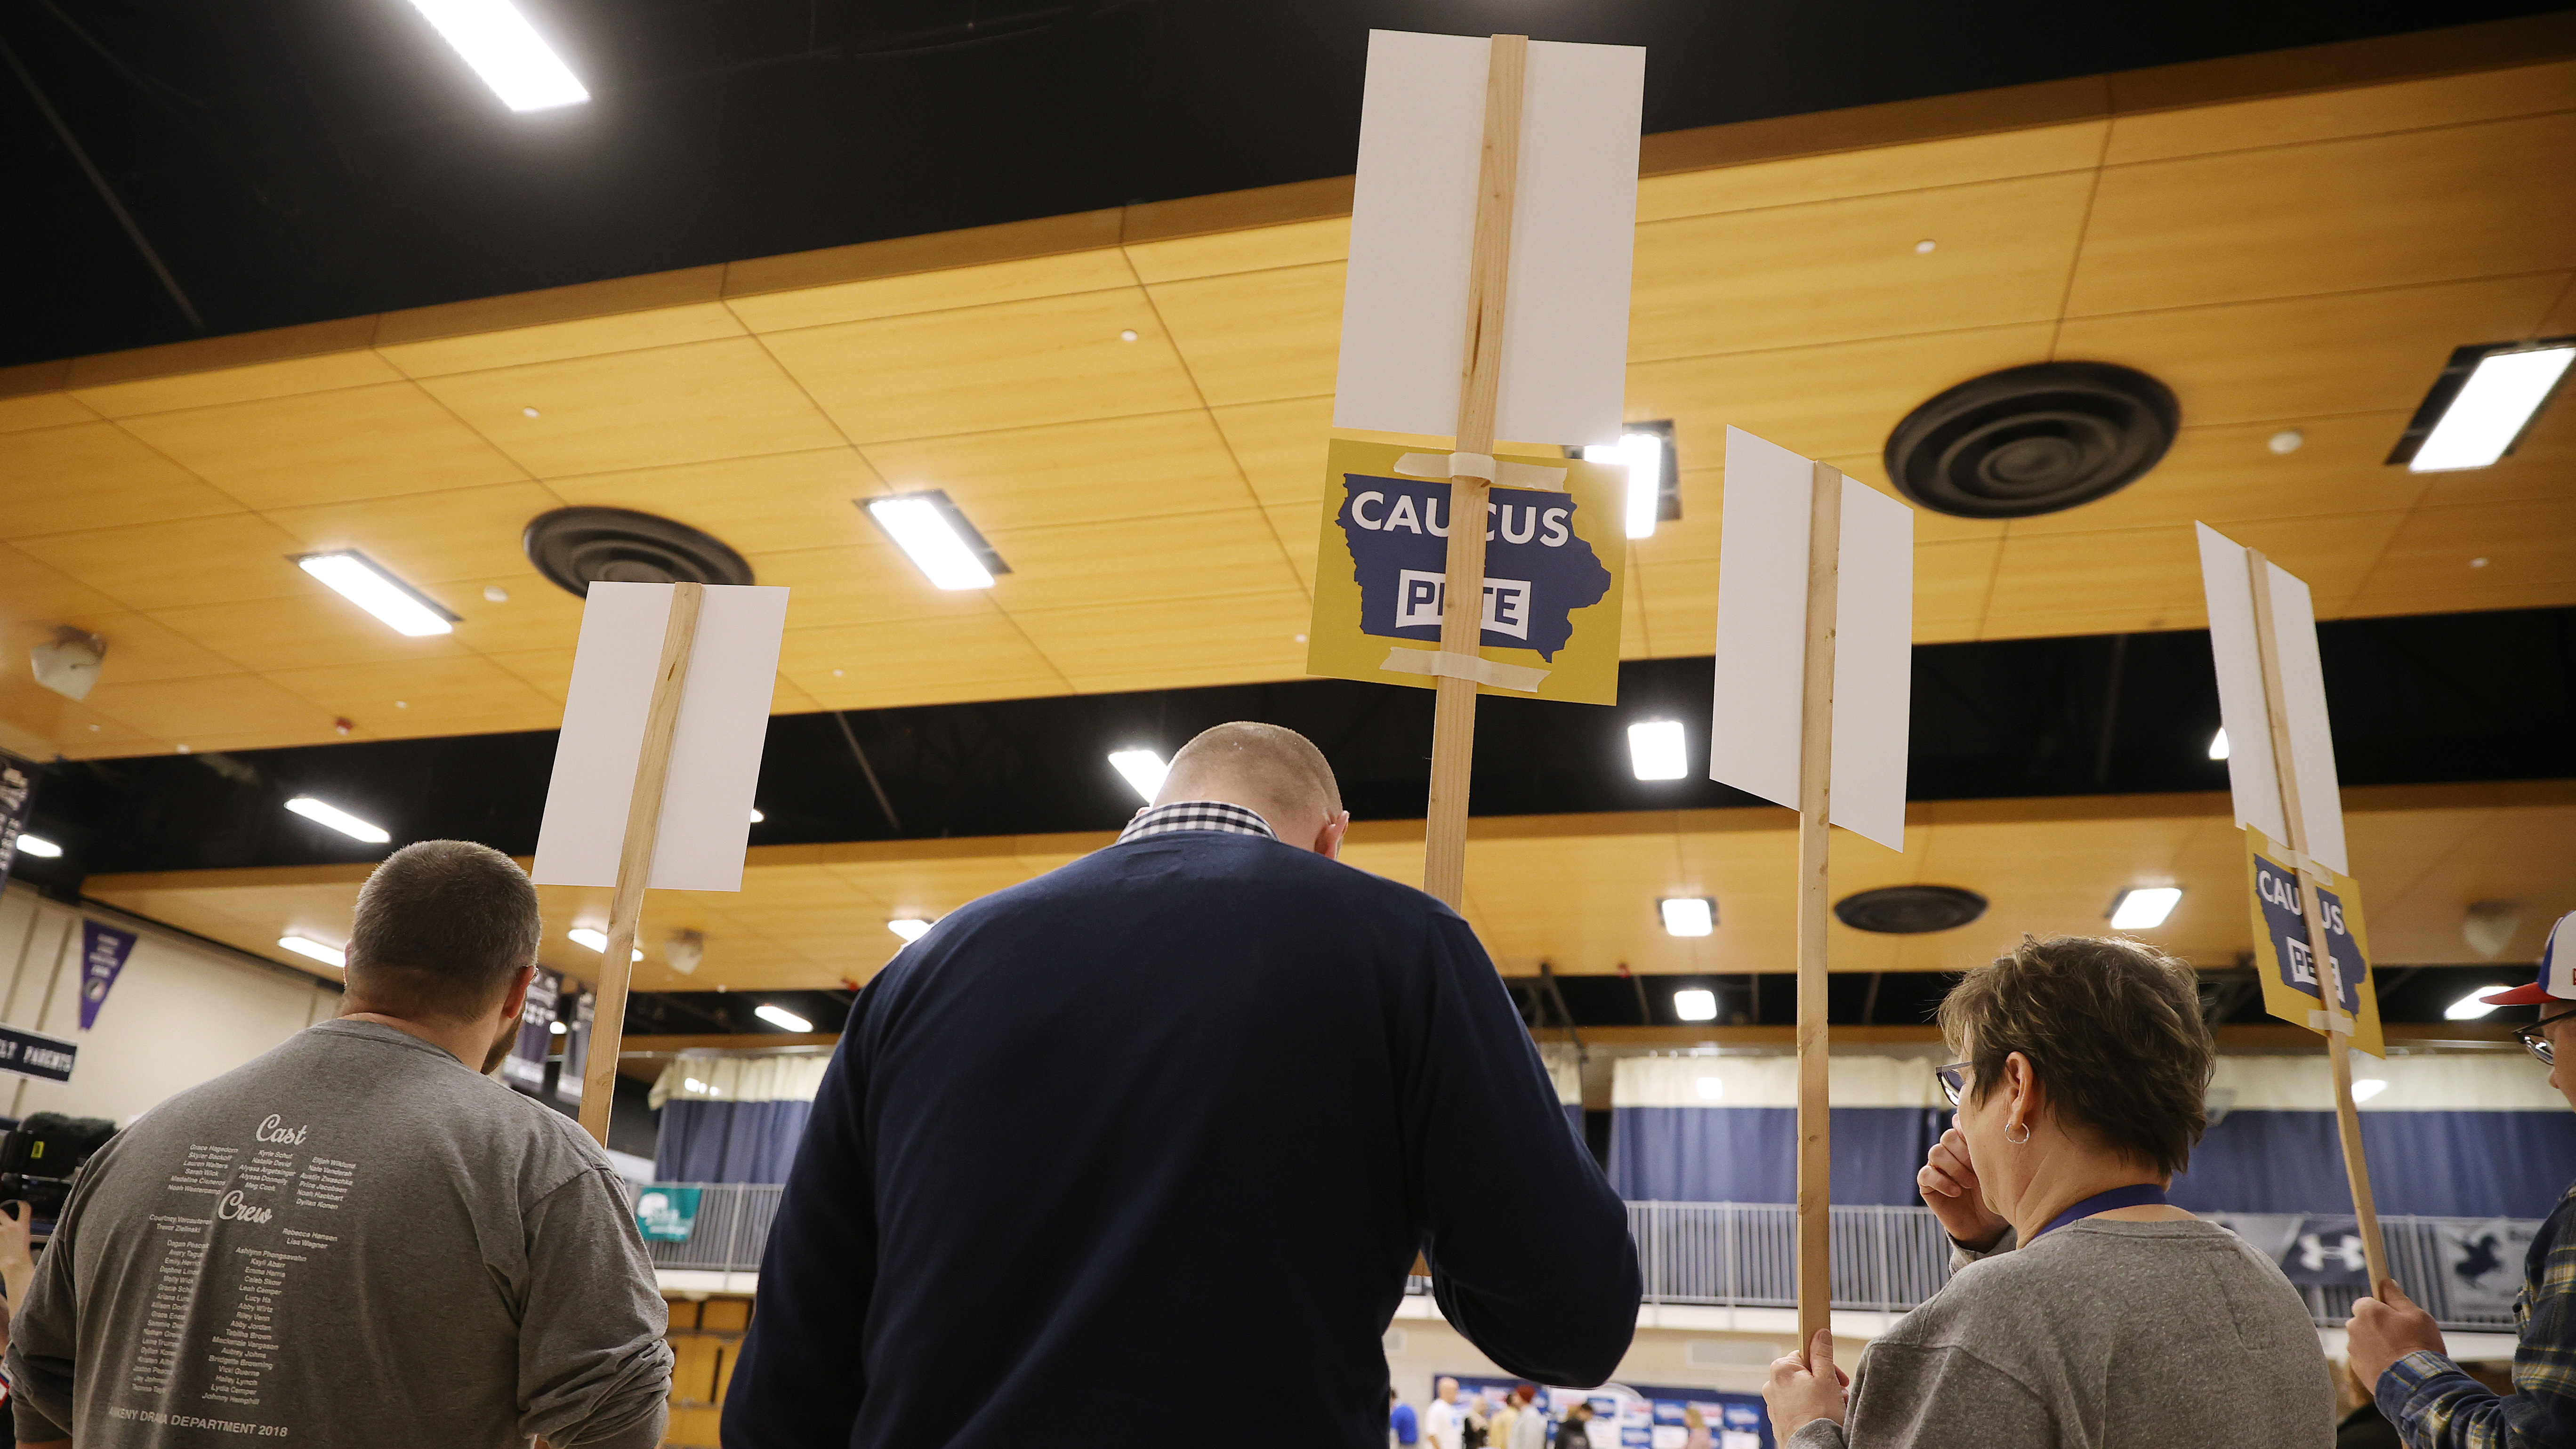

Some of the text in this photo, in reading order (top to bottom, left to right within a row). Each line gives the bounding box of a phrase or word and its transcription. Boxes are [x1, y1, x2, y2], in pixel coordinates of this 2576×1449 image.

[1407, 580, 1521, 626] PE
[2259, 870, 2345, 936] CAUUS
[256, 1114, 307, 1145] Cast
[218, 1190, 273, 1224] Crew
[170, 1415, 257, 1434] DEPARTMENT
[258, 1425, 289, 1437] 2018
